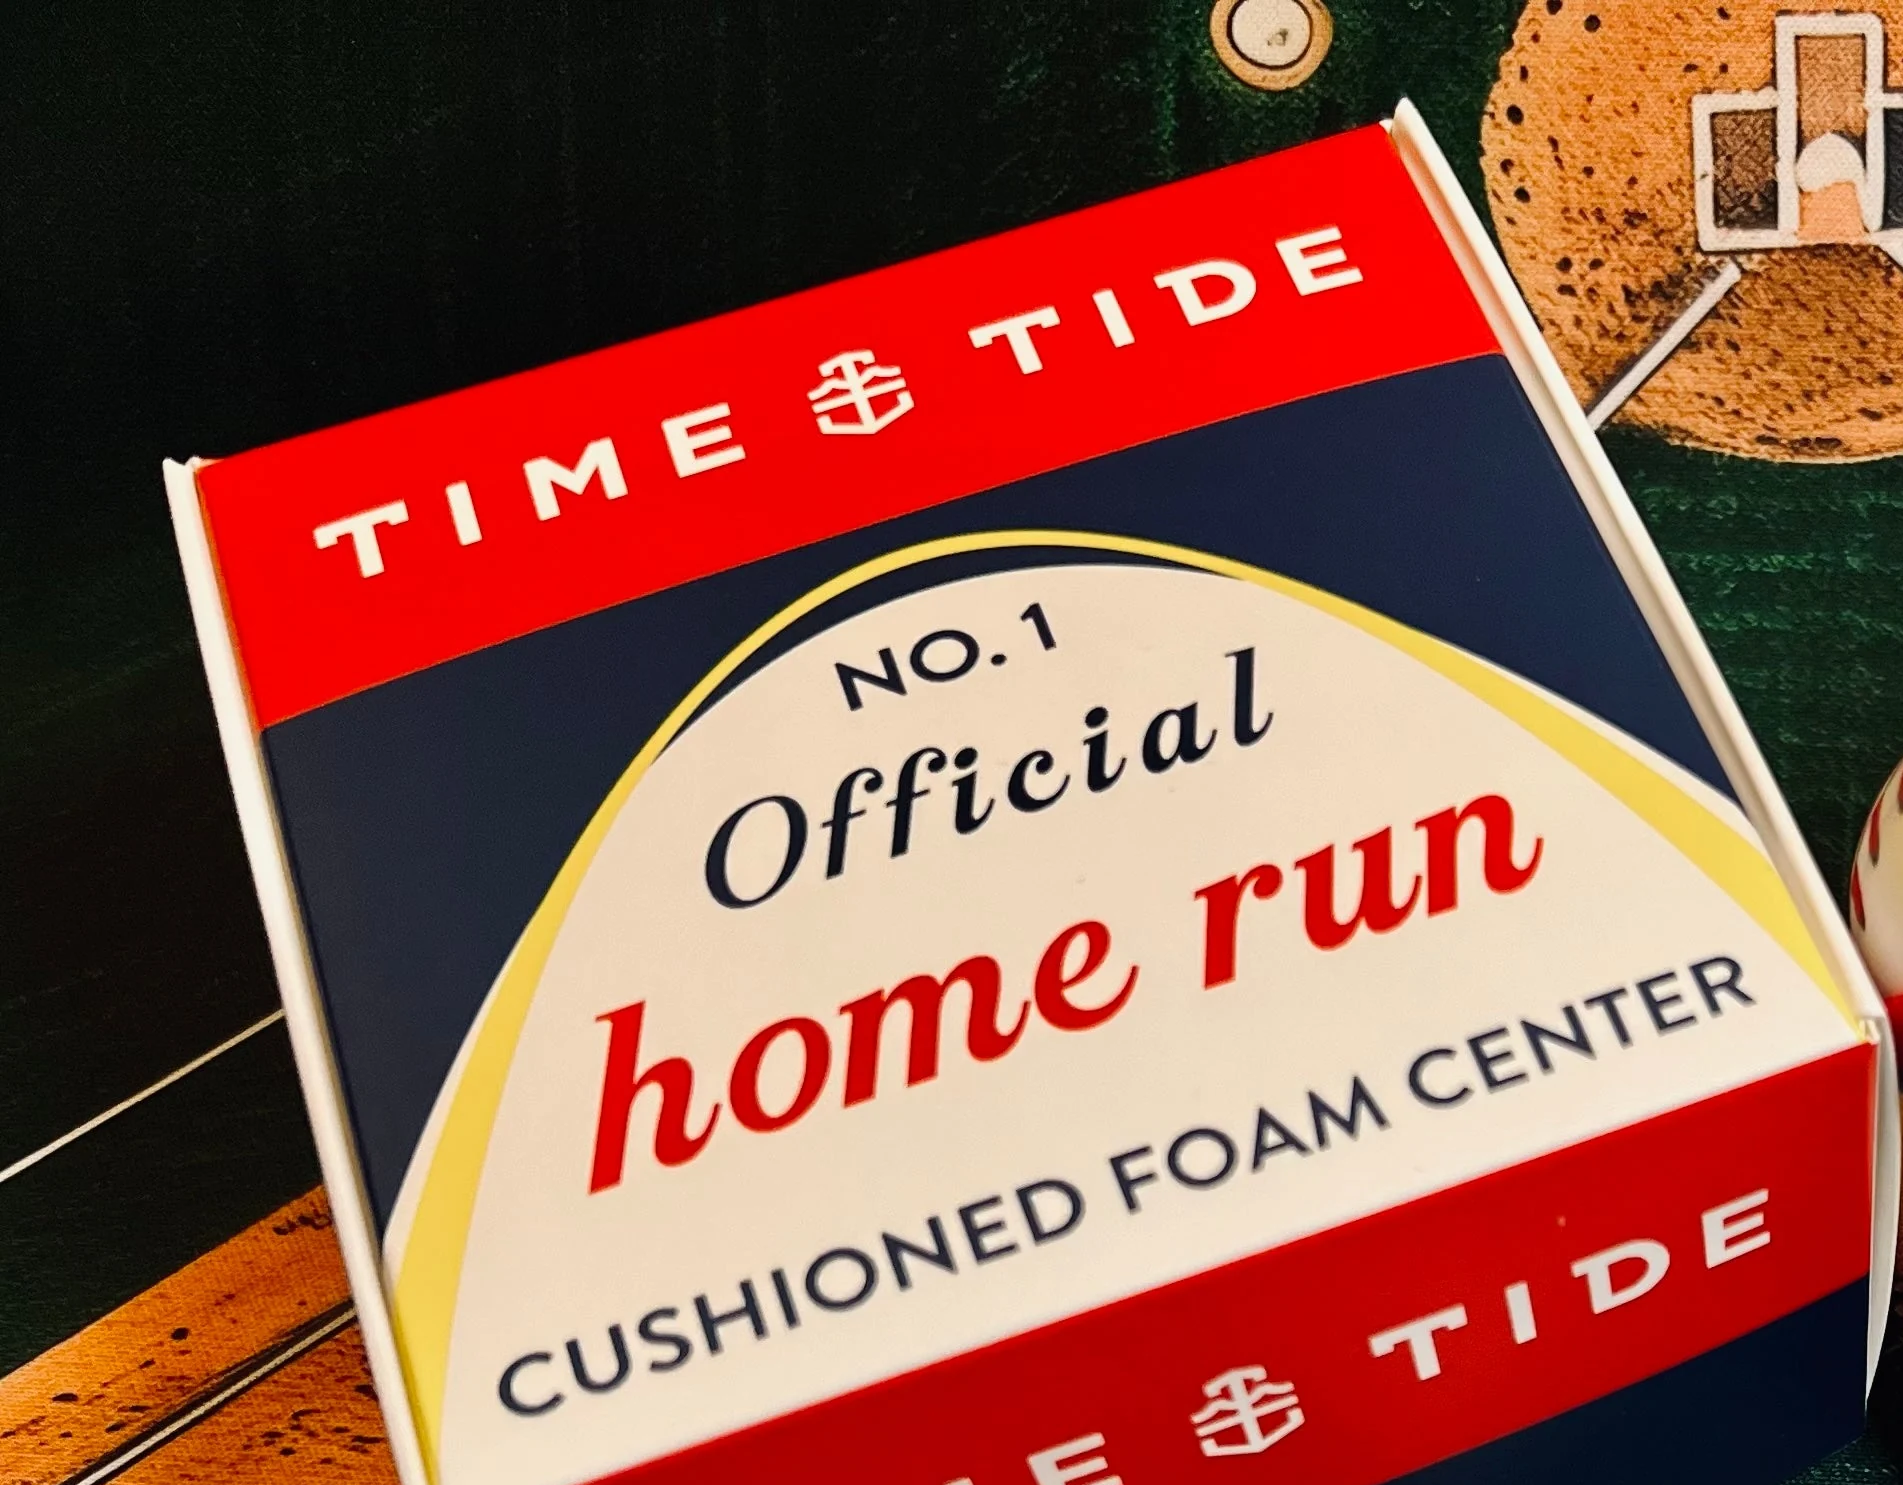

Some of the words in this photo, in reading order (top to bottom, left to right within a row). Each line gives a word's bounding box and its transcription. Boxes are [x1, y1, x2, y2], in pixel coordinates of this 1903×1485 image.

[313, 402, 747, 579] TIME
[967, 226, 1364, 376] TIDE
[704, 646, 1275, 910] Official
[586, 918, 1141, 1197] home
[1191, 791, 1546, 992] run
[497, 1178, 1084, 1418] CUSHIONED
[1108, 1075, 1388, 1212] FOAM
[1407, 955, 1754, 1107] CENTER
[1369, 1189, 1773, 1382] TIDE
